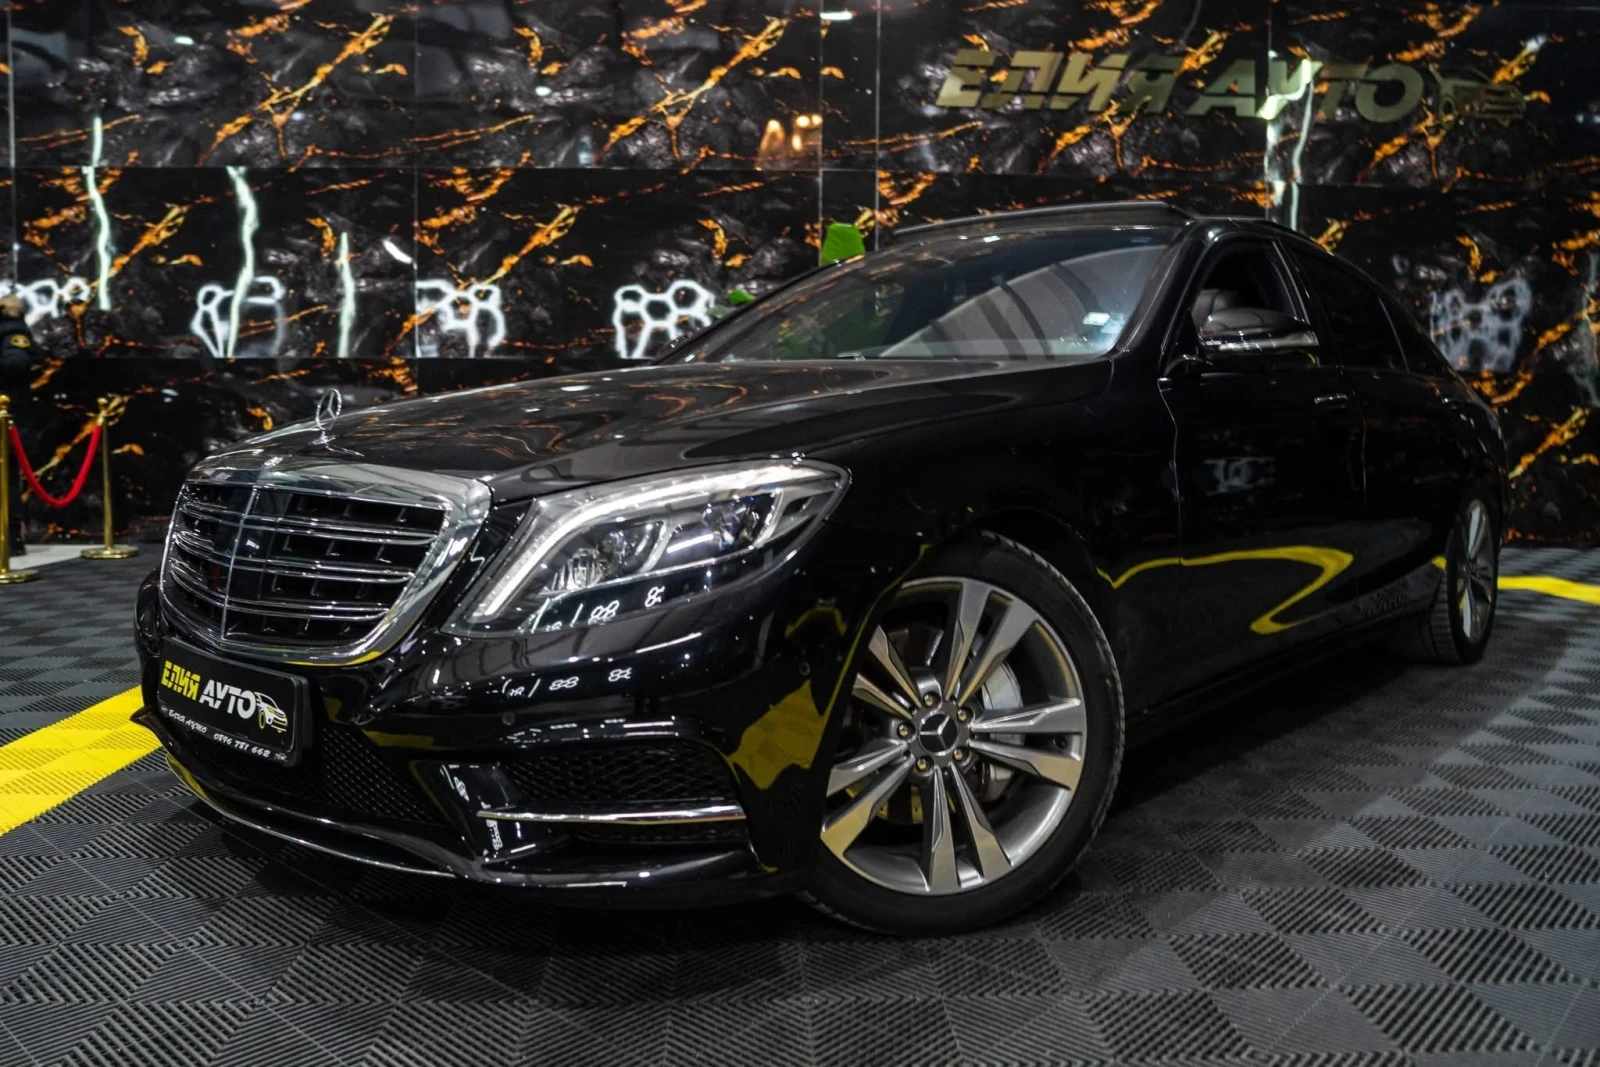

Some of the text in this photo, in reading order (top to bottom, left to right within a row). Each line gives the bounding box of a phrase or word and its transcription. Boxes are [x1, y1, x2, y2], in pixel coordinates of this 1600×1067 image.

[161, 660, 200, 700] ЕЛИЯ
[213, 733, 233, 745] 0896
[234, 740, 250, 751] 781
[251, 746, 272, 758] 662
